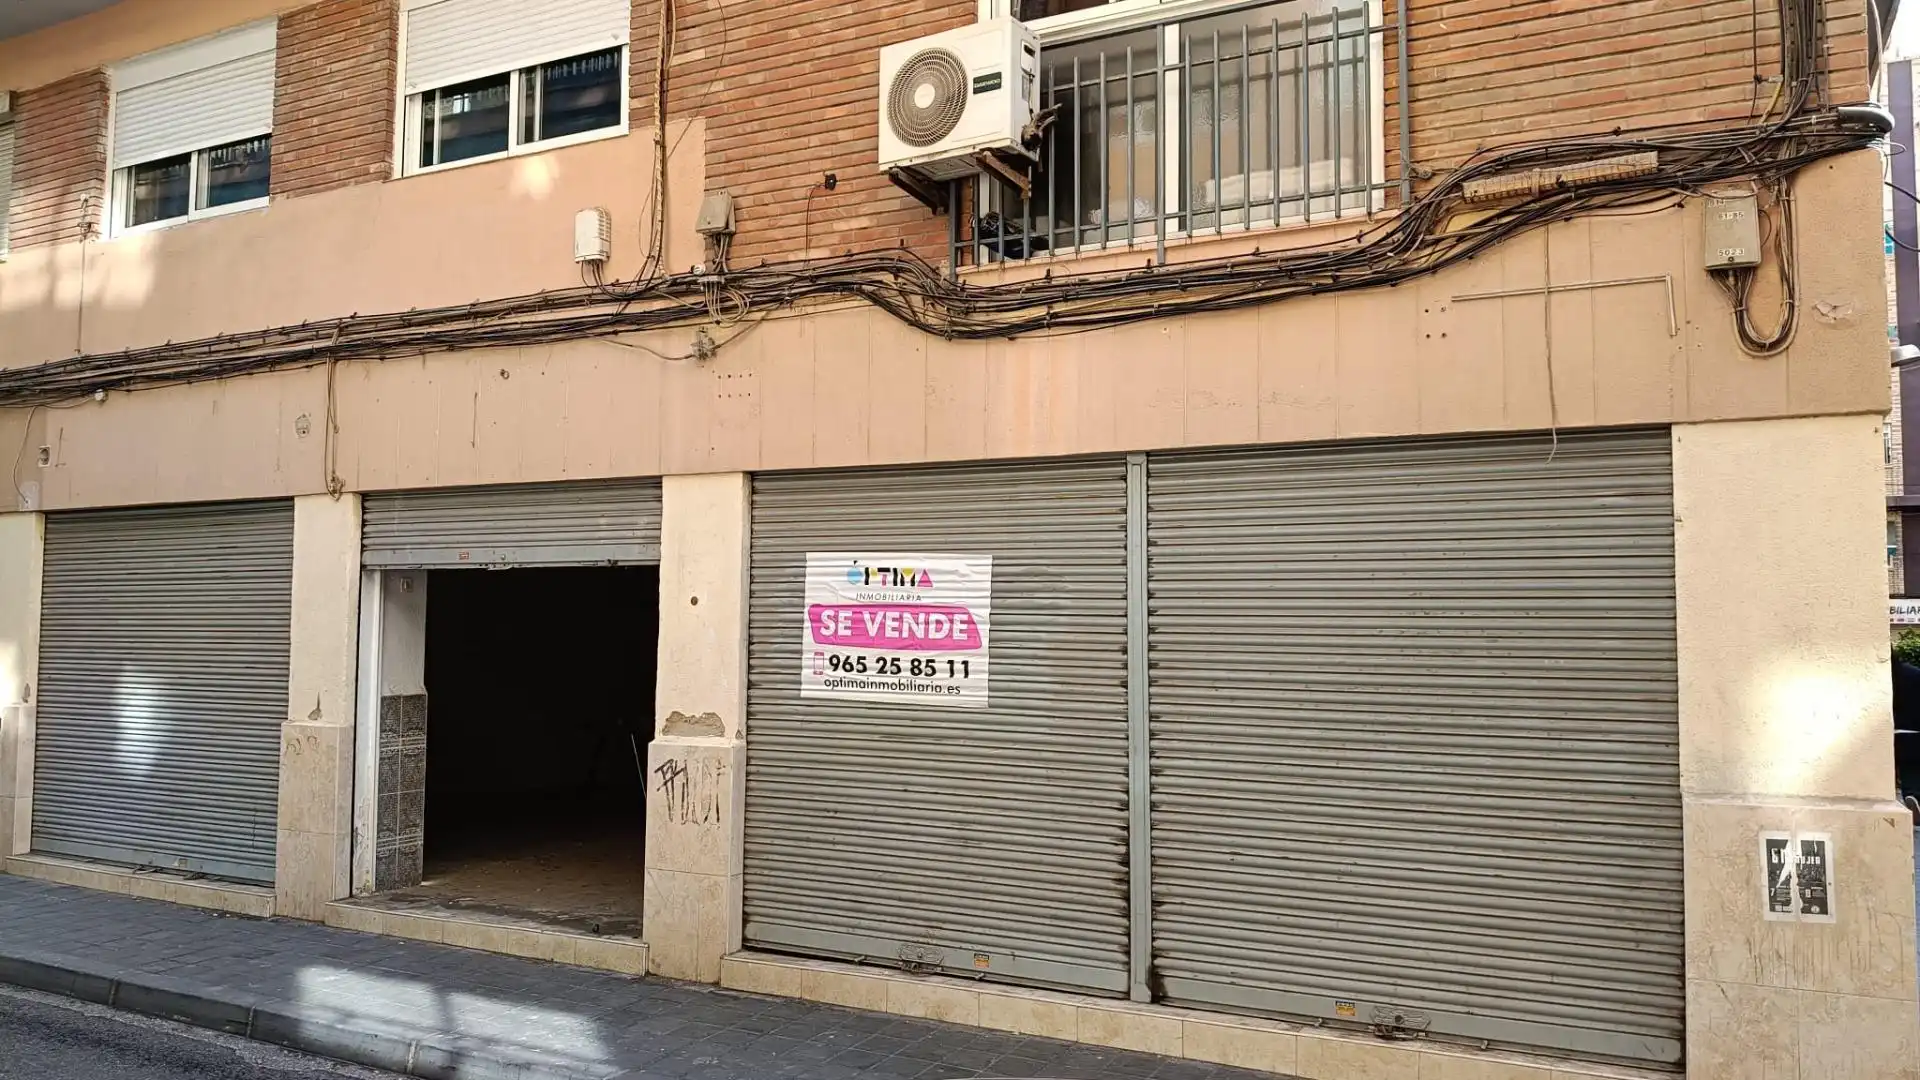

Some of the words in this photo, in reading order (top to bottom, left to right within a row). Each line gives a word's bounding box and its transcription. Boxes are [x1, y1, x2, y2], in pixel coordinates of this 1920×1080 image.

[855, 593, 922, 601] INMOBILIARIA
[819, 609, 852, 637] SE
[862, 611, 969, 641] VENDE
[828, 654, 868, 674] 965
[875, 657, 902, 676] 25
[909, 658, 937, 677] 85
[947, 660, 969, 679] 11
[824, 676, 961, 695] optimainmobiliaria.es
